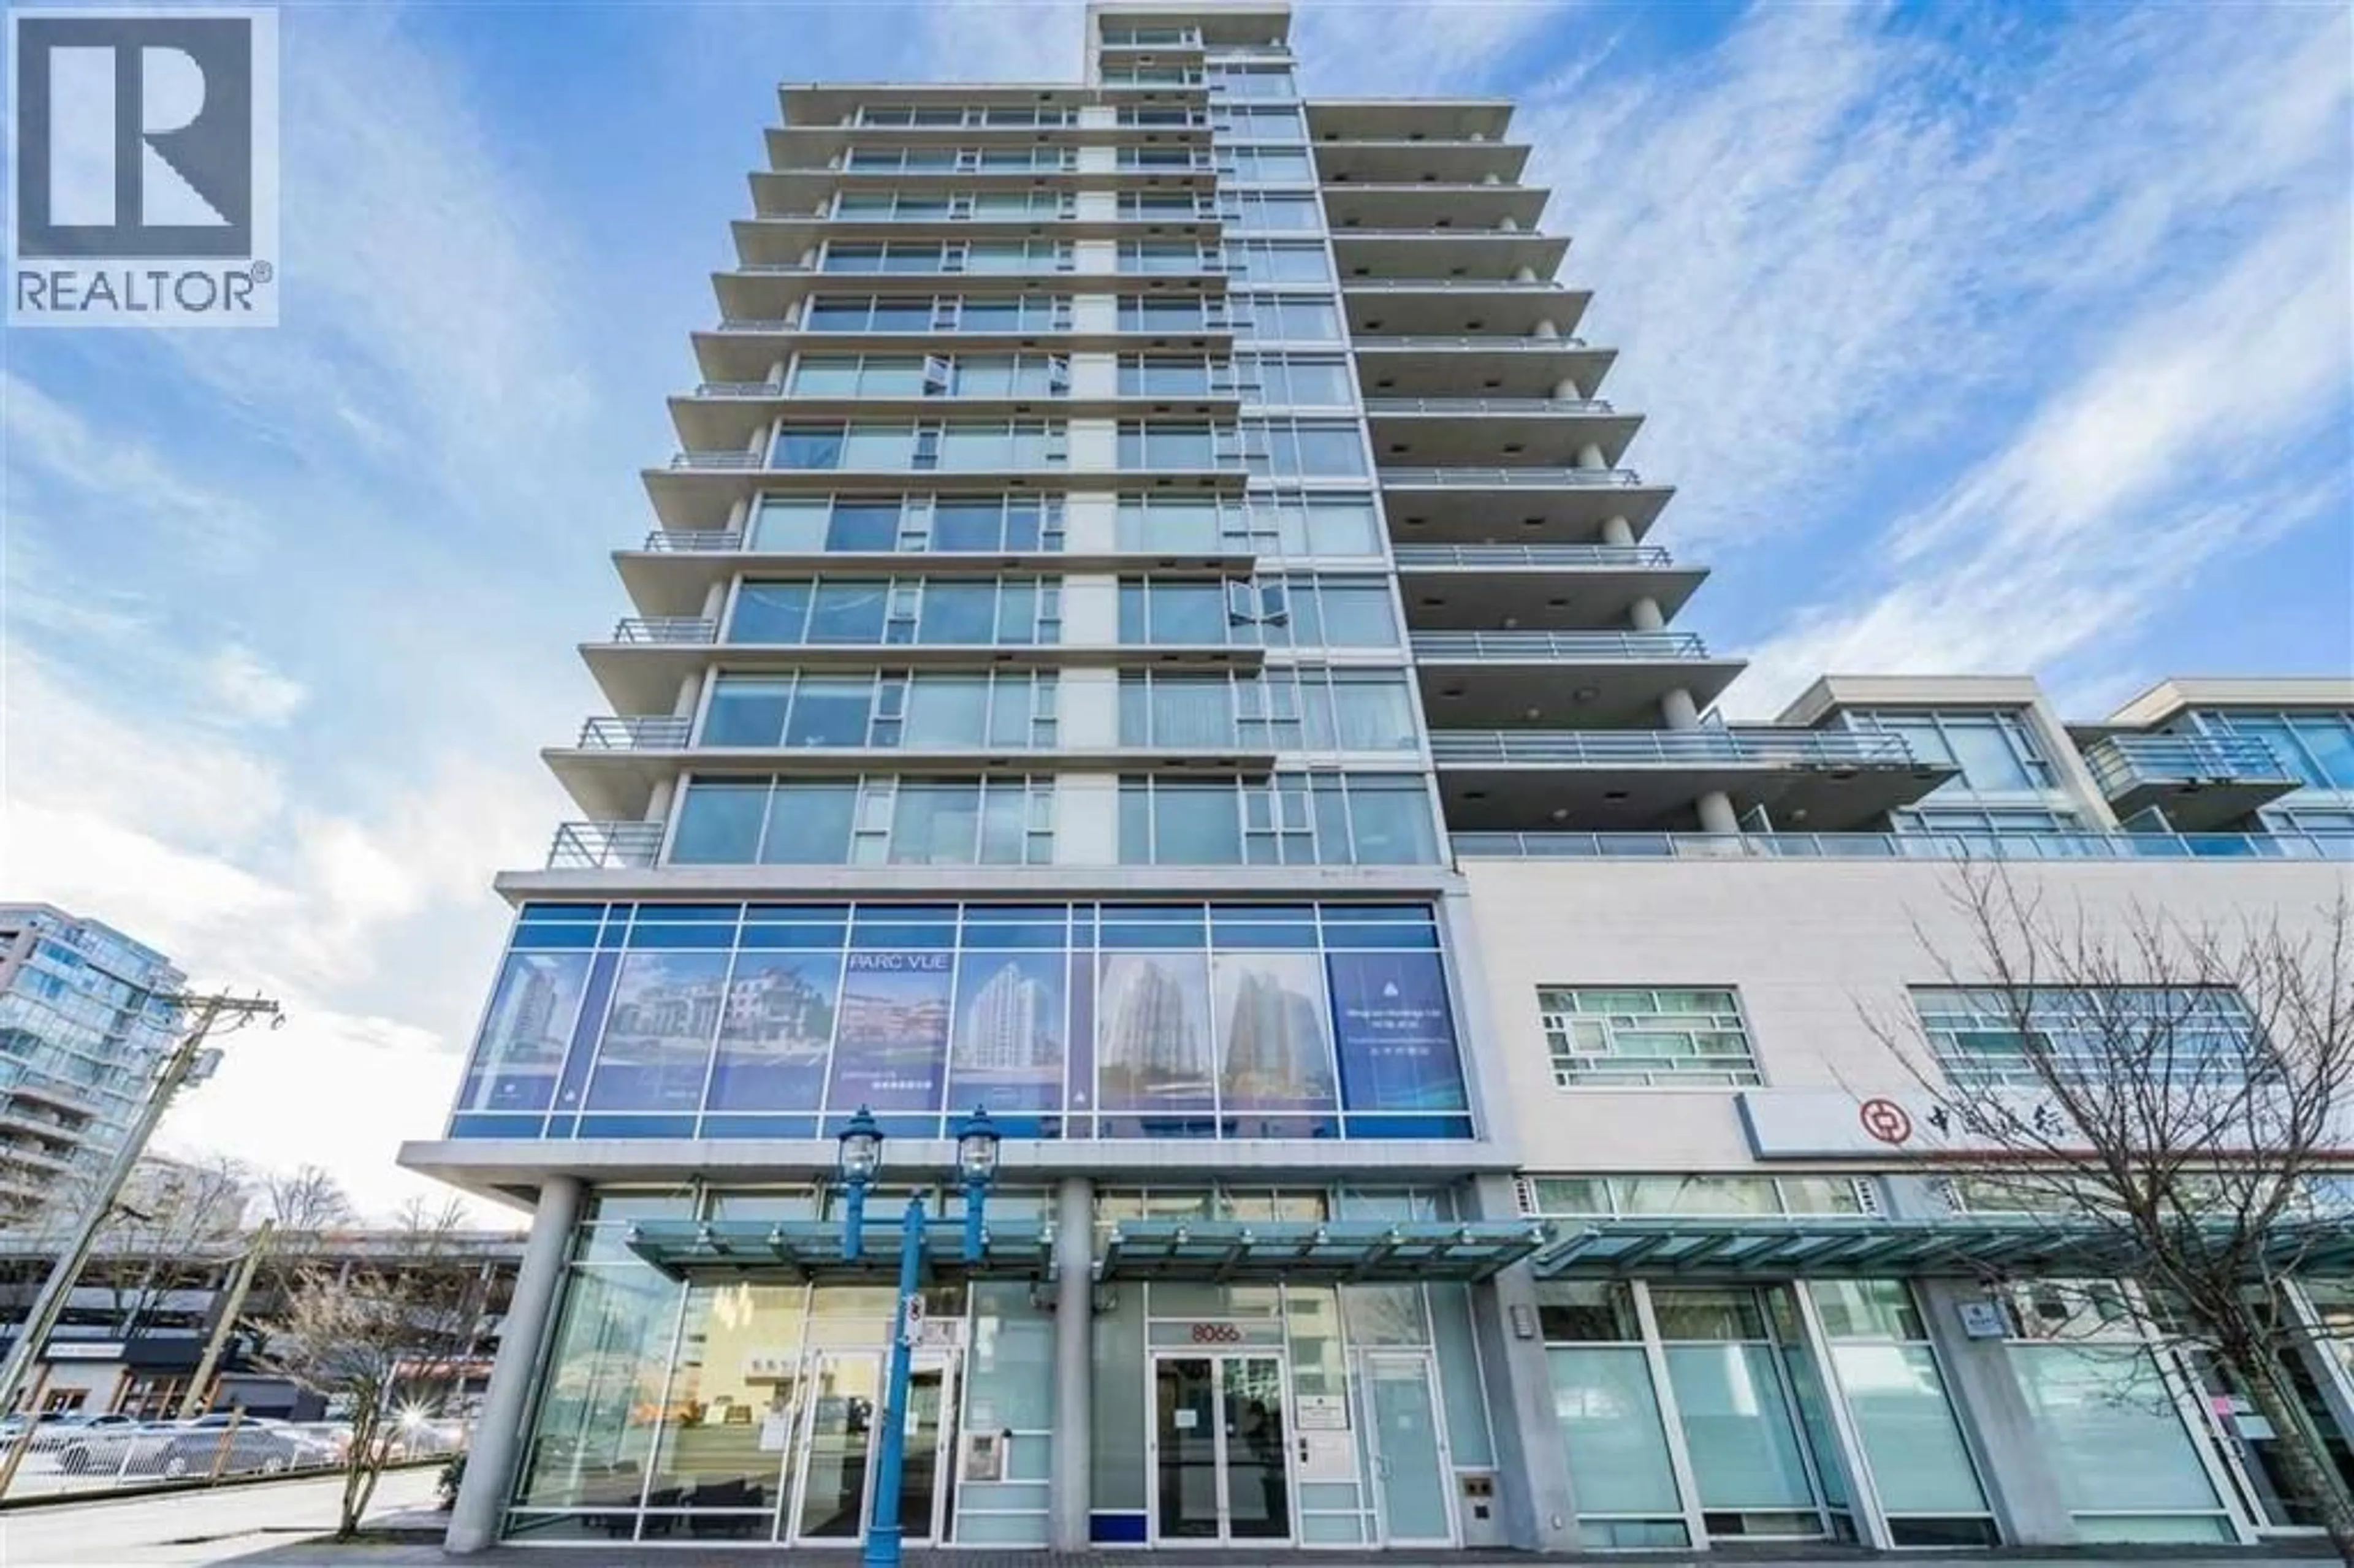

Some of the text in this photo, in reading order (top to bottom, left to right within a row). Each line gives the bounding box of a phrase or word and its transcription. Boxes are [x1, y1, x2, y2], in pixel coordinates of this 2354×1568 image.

[850, 954, 950, 969] PARC VUE
[1192, 1323, 1241, 1342] 8066
